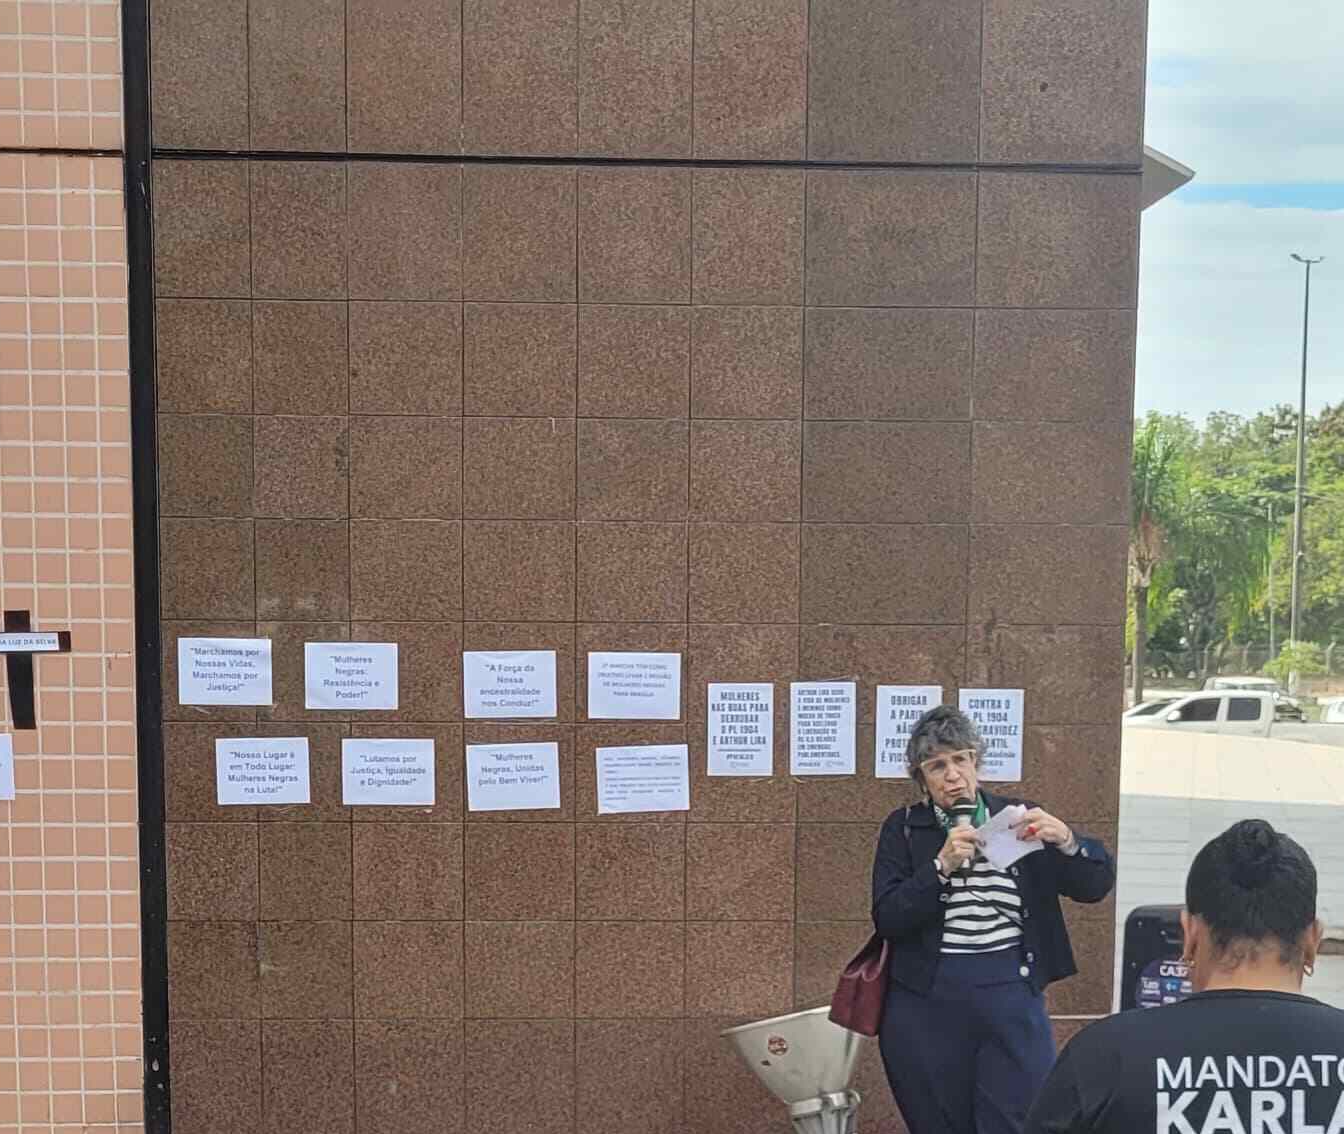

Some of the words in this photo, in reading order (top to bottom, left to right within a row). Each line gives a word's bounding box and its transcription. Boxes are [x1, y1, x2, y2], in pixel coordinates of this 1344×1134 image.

[245, 648, 260, 658] por
[721, 692, 760, 701] MULHERES
[891, 696, 927, 705] OBRIGAR
[968, 699, 1001, 709] CONTRA
[890, 710, 896, 719] A
[987, 712, 1008, 722] 1904
[264, 752, 288, 760] Lugar
[269, 775, 298, 783] Negras
